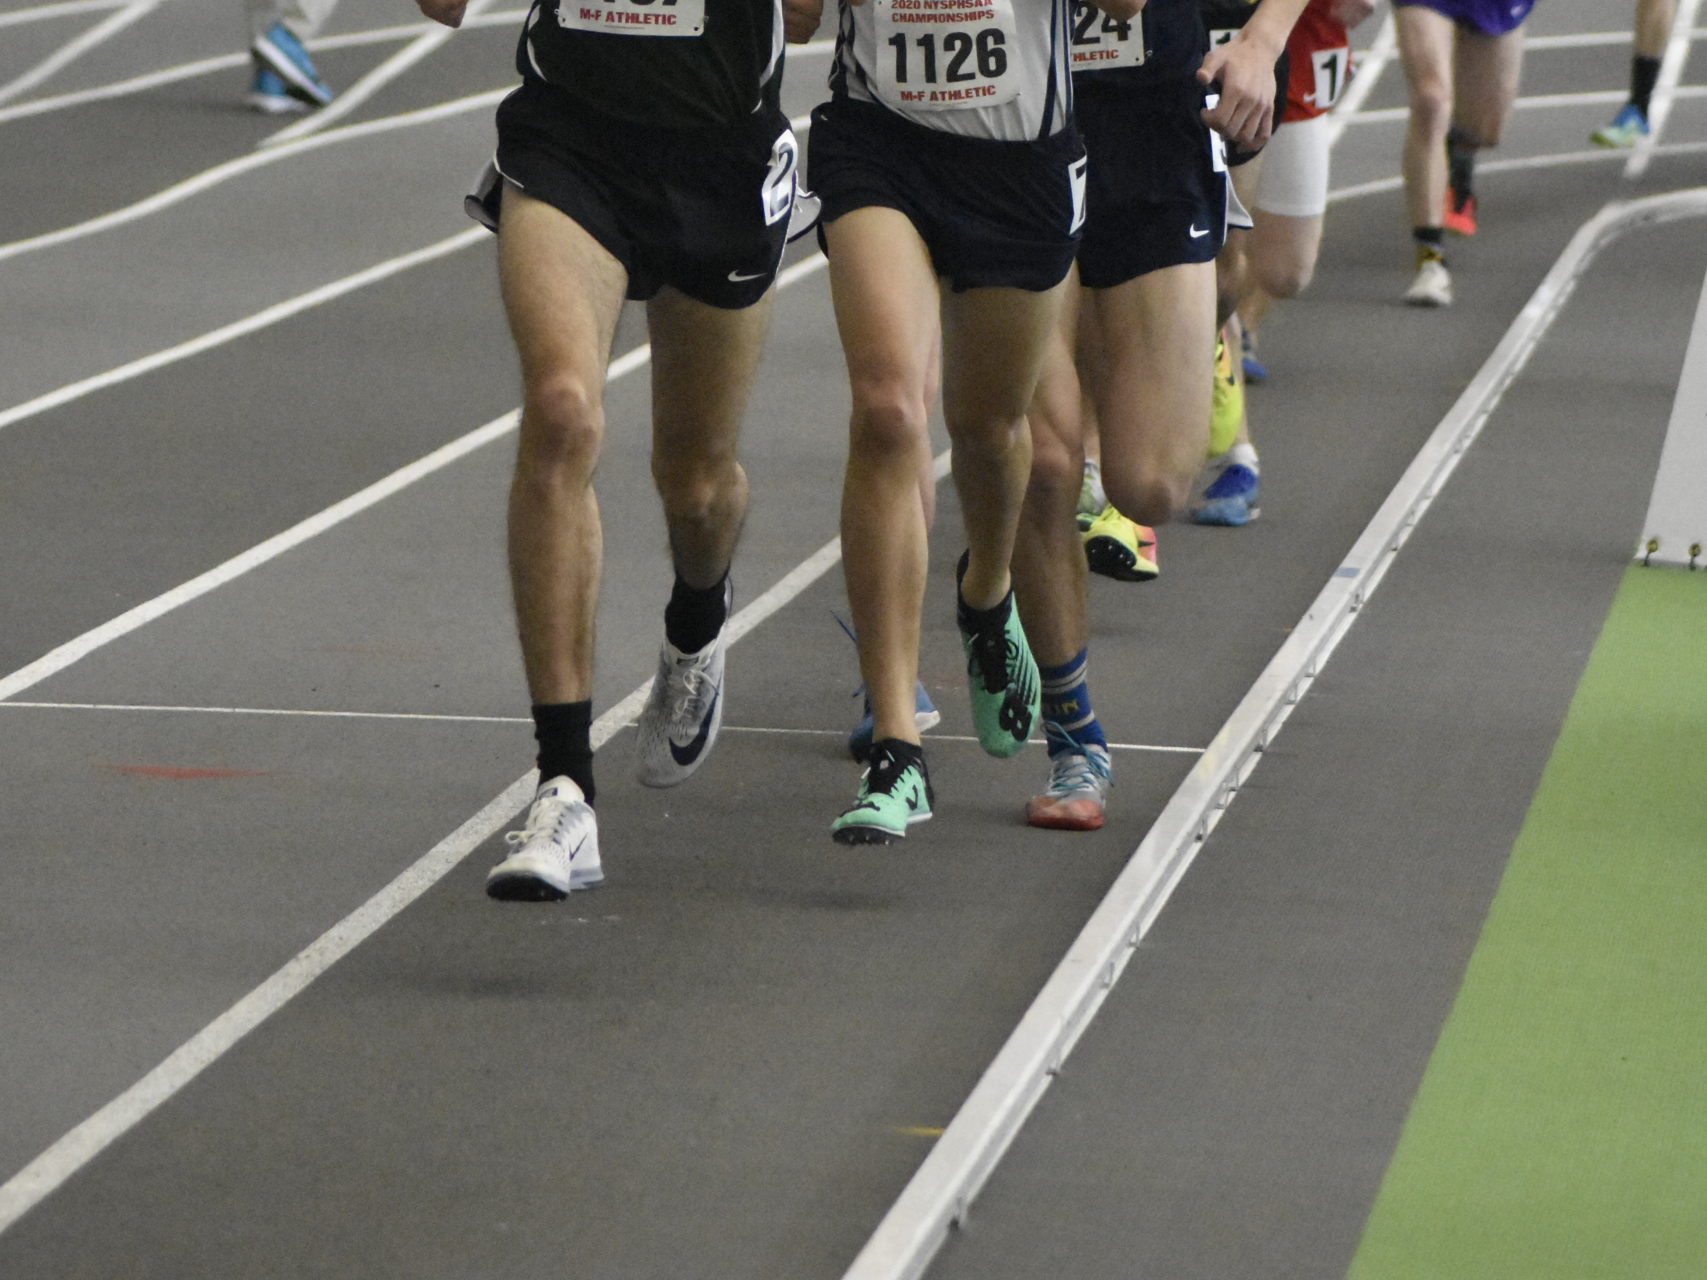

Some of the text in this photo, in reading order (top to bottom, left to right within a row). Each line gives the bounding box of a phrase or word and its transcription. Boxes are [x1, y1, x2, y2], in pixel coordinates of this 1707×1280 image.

[891, 0, 921, 10] 2020
[579, 7, 677, 26] M-F ATHLETIC
[891, 9, 995, 24] CHAMPIONSHIPS
[1071, 0, 1132, 46] 24
[888, 27, 1008, 84] 1126
[1071, 49, 1120, 63] HLETIC
[1320, 53, 1338, 102] 1
[900, 84, 996, 102] M-F ATHLETIC
[770, 142, 793, 218] 2
